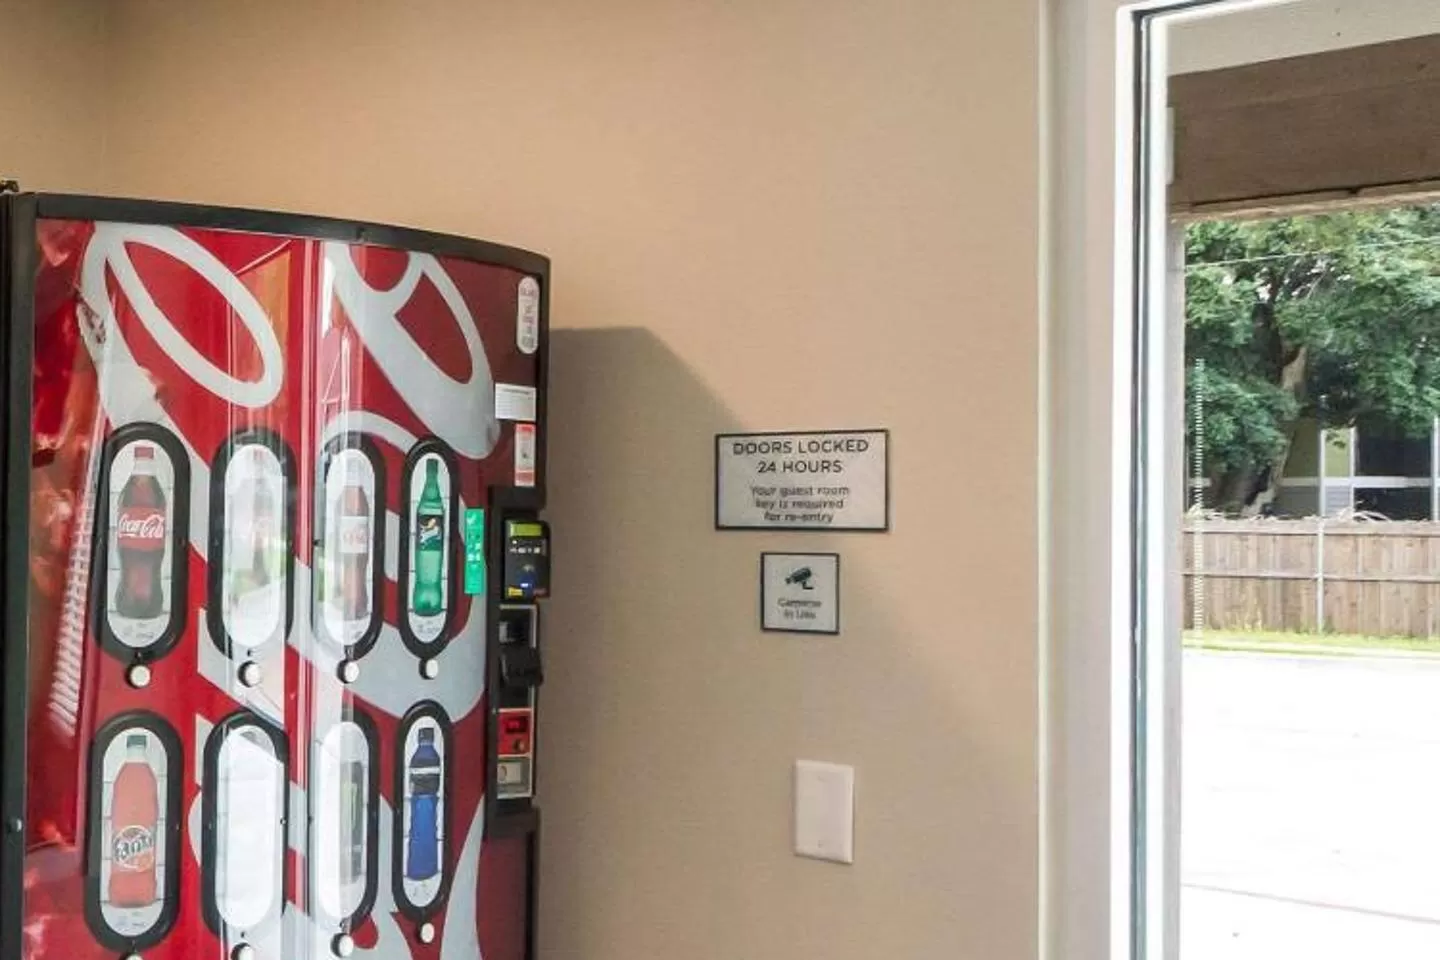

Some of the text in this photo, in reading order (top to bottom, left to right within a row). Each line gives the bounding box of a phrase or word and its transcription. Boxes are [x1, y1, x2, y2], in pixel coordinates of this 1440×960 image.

[733, 439, 869, 455] DOORS LOCKED
[758, 460, 843, 474] 24 HOURS
[751, 486, 851, 498] Your guest room
[756, 499, 844, 511] key is required
[764, 511, 834, 524] for re-entry
[118, 512, 165, 539] Coca-Cola
